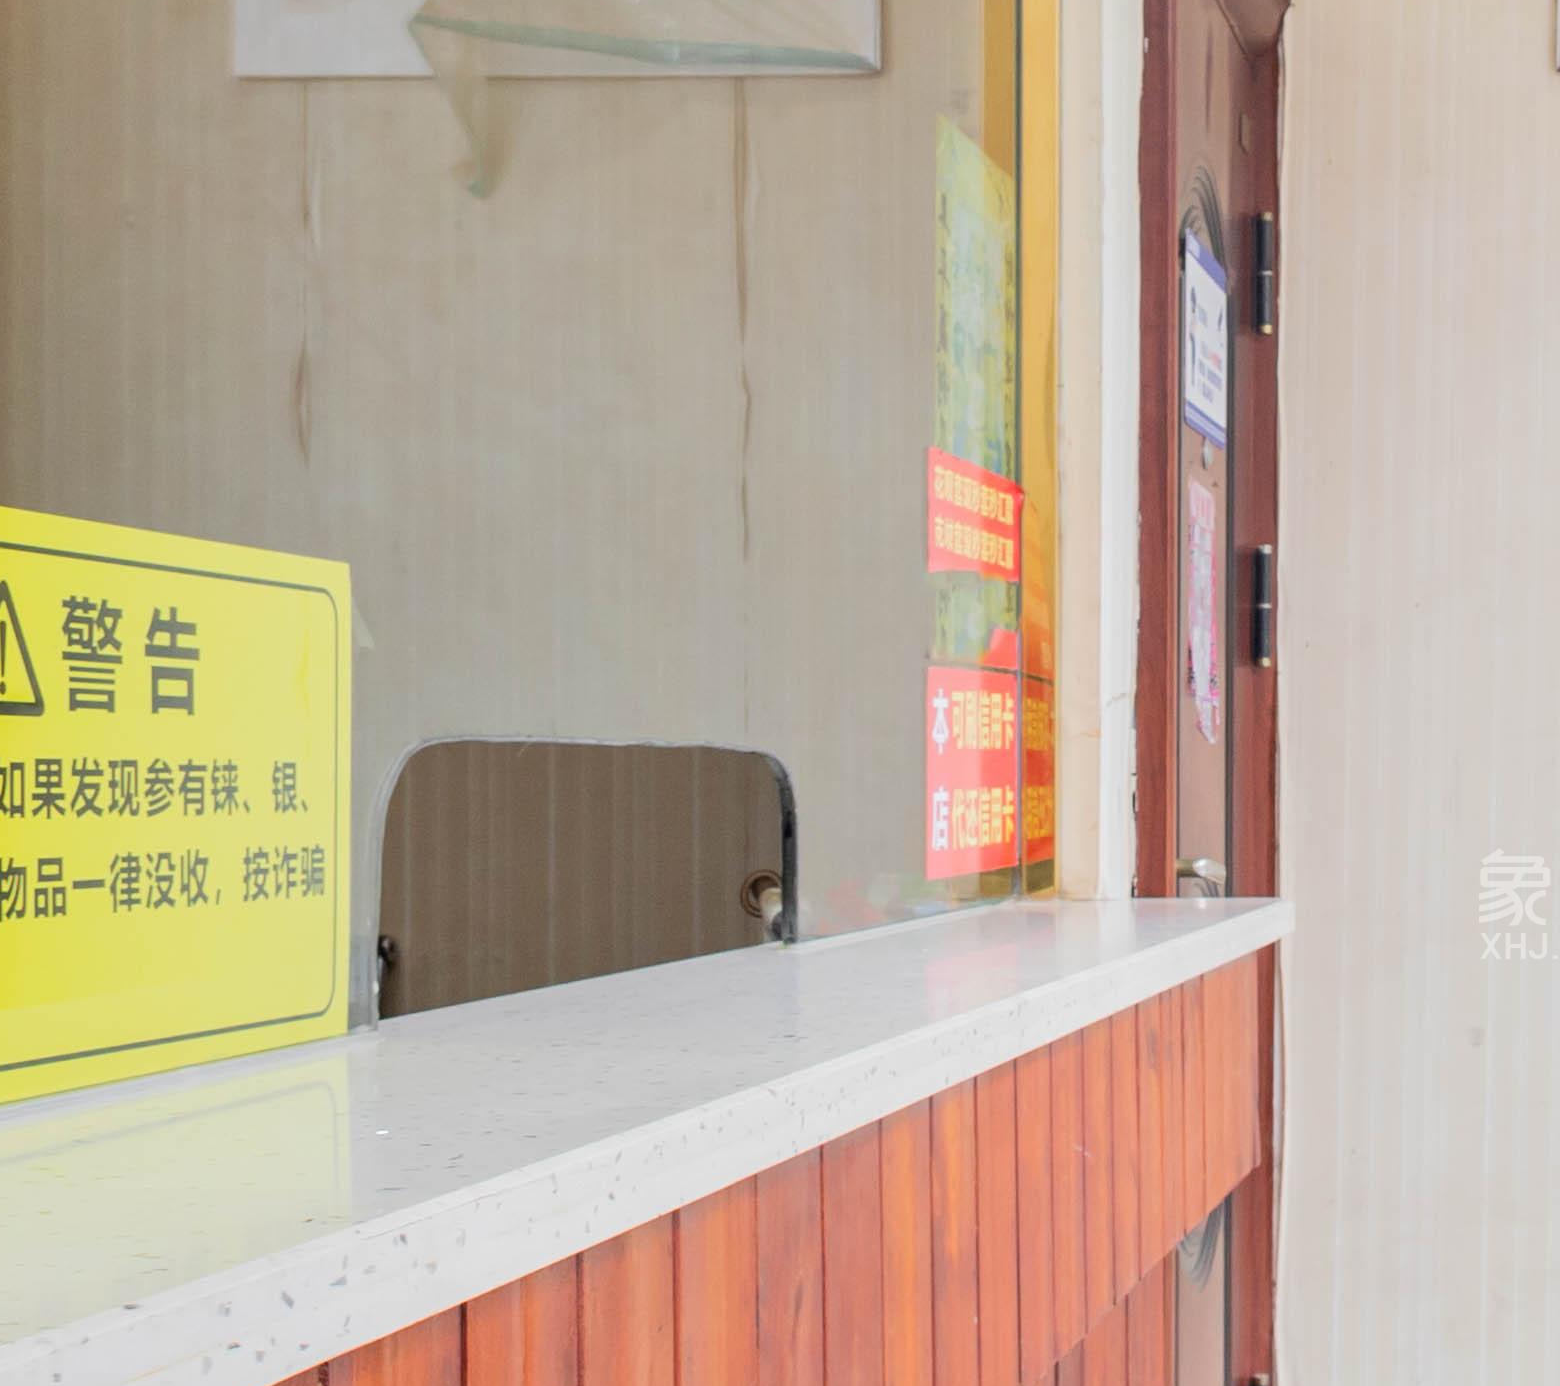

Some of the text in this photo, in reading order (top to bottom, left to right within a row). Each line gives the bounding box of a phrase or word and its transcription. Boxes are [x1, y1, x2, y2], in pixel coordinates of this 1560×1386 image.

[61, 595, 201, 716] 警告
[952, 690, 1014, 750] 可刷信用卡
[952, 786, 1014, 850] 代还信用卡
